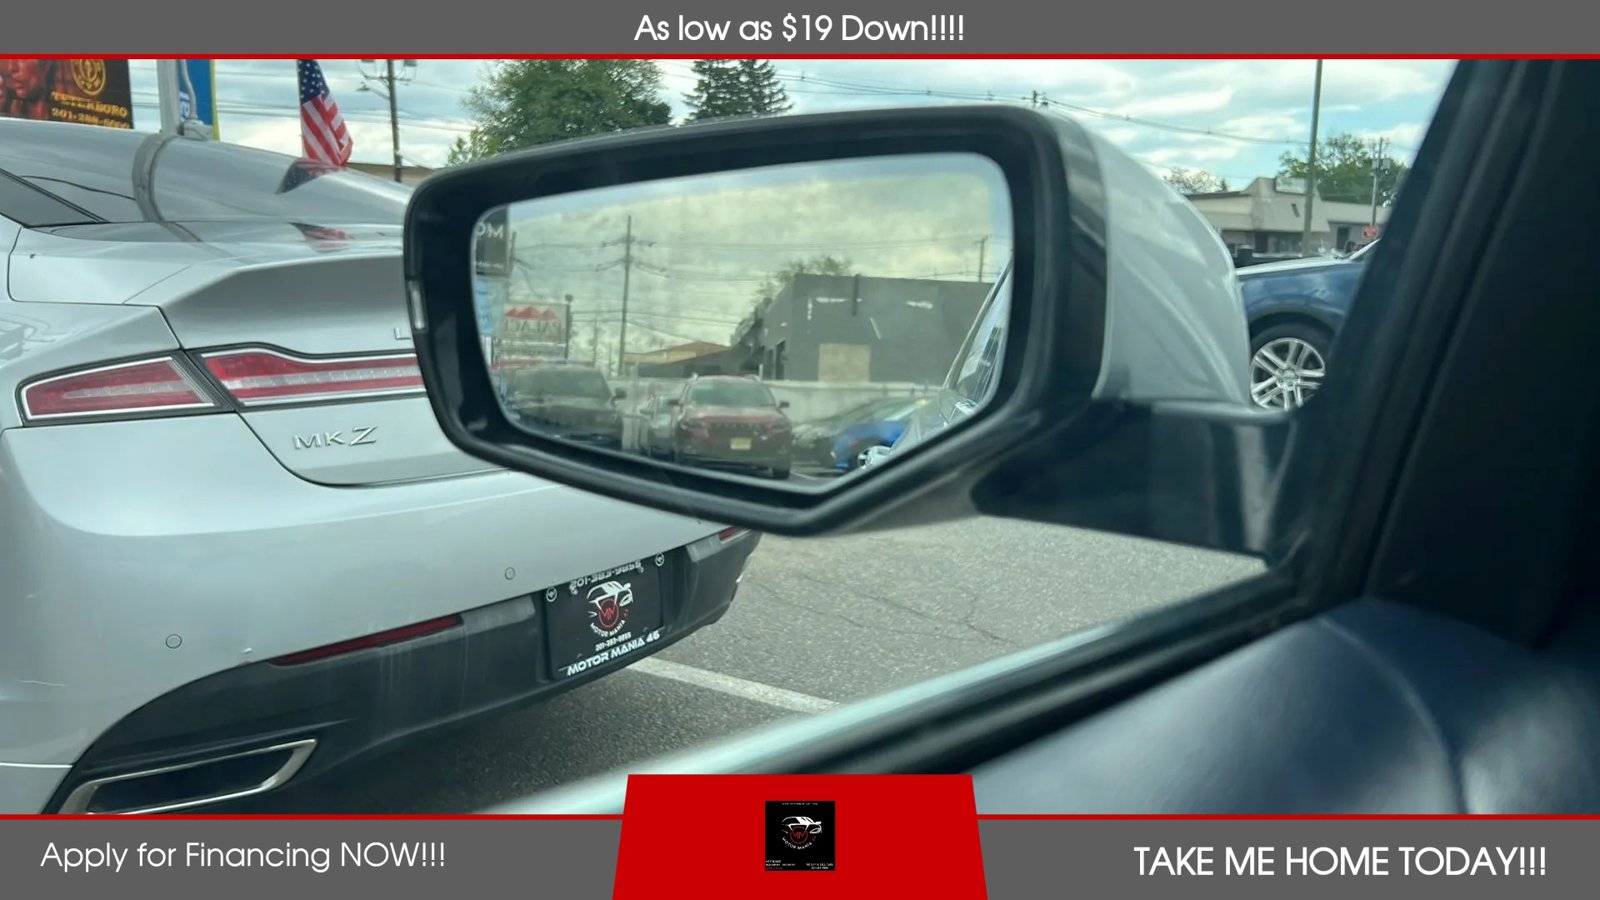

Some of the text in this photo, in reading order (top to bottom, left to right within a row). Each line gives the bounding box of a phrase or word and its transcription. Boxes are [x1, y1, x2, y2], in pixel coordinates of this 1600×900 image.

[293, 426, 377, 450] MKZ
[567, 651, 610, 676] MOTOR
[610, 636, 645, 658] MANIA
